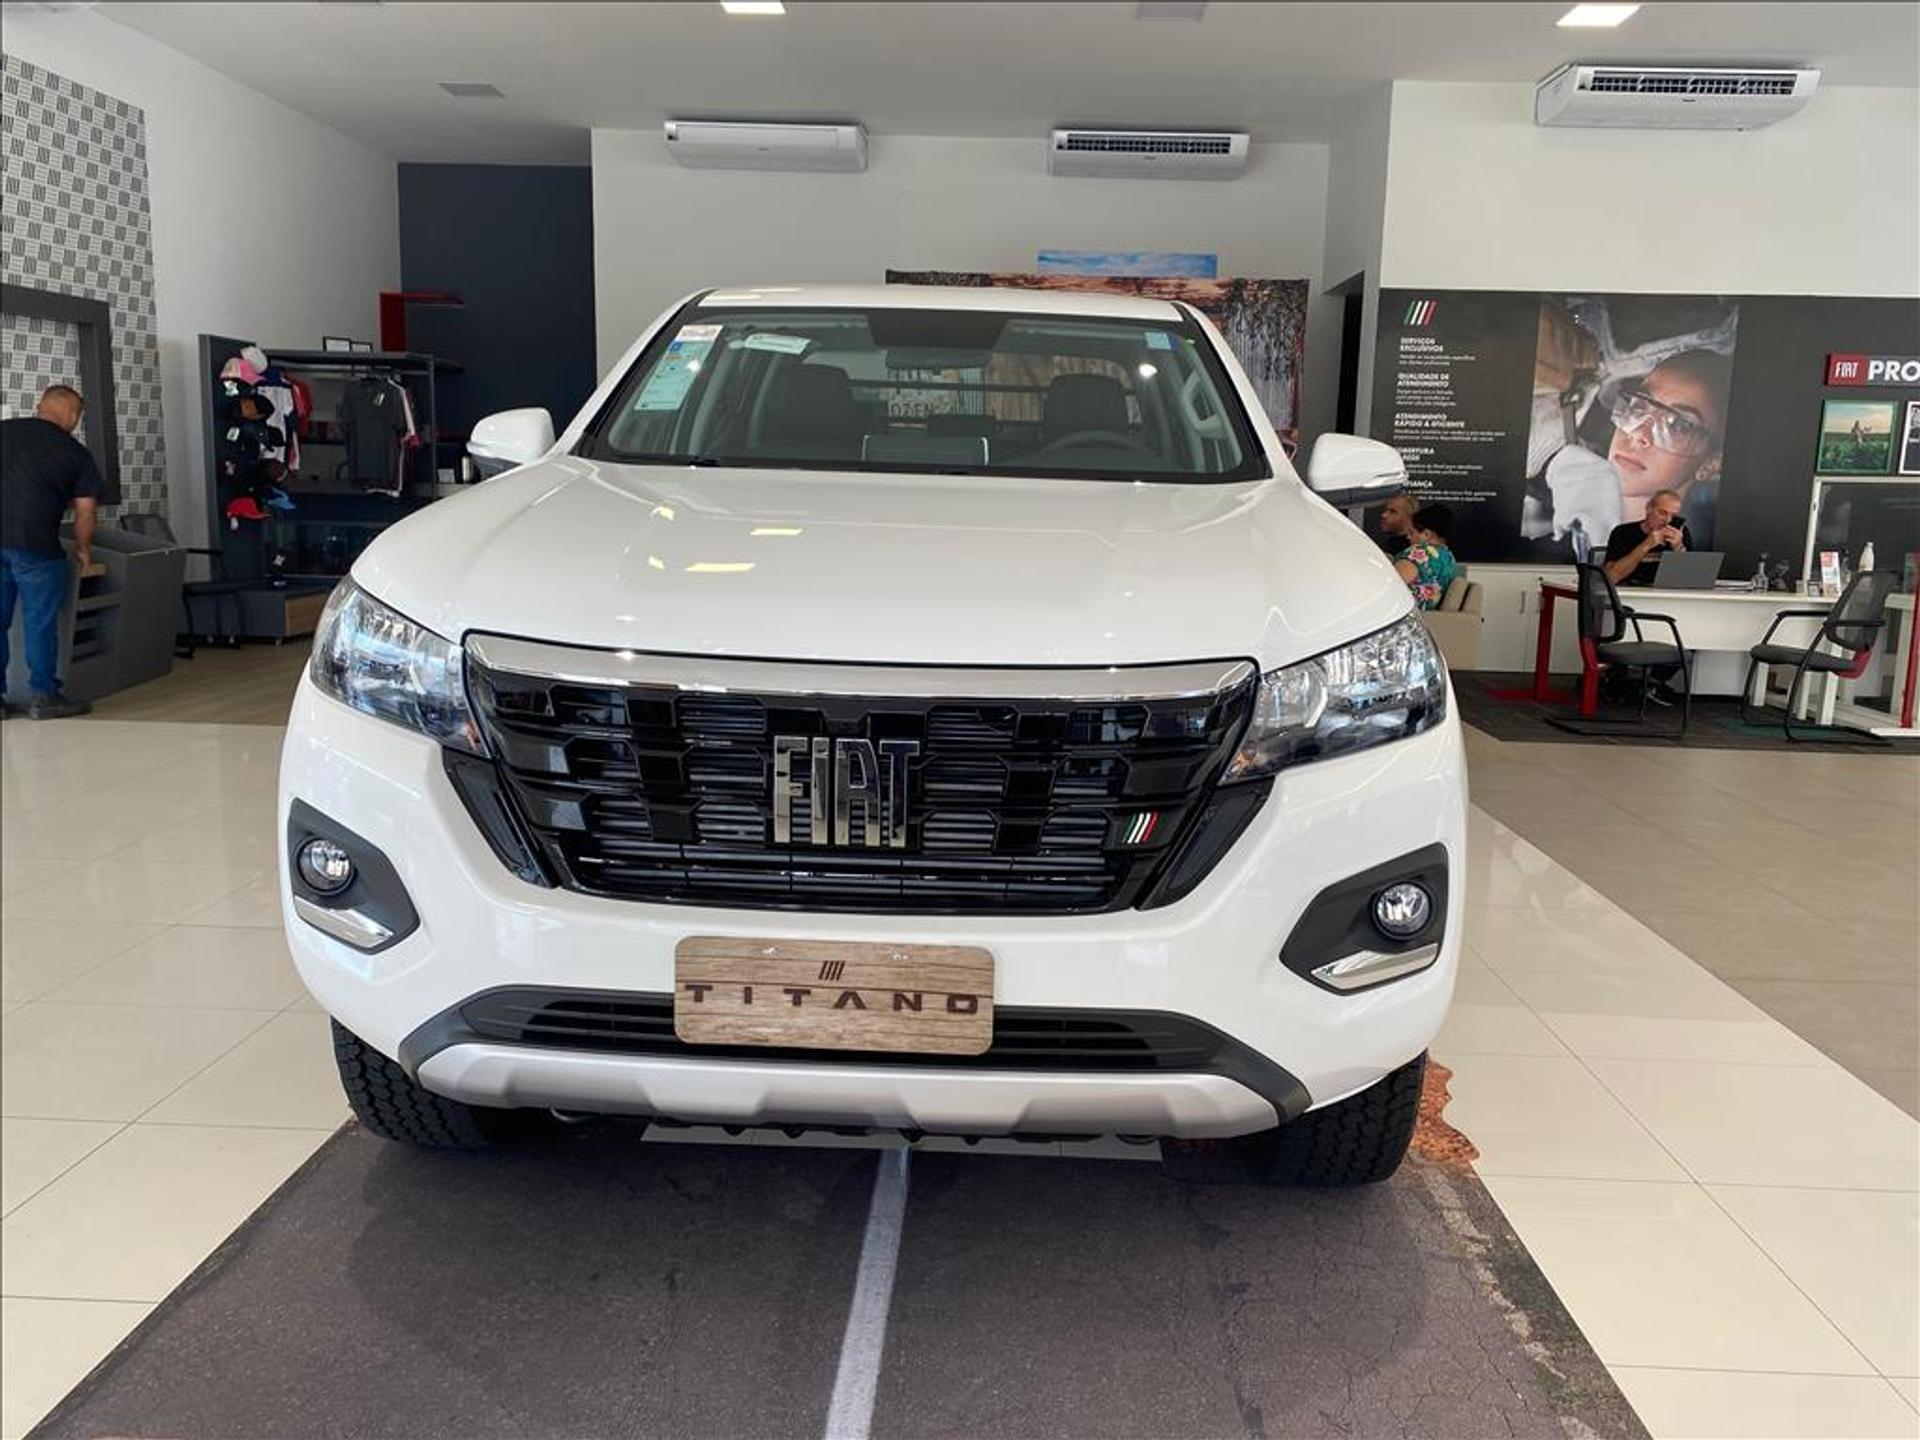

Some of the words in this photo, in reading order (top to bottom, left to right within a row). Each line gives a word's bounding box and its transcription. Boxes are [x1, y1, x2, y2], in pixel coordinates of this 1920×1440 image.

[1397, 373, 1439, 381] QUALIDADE
[1834, 361, 1860, 379] FIAT
[1867, 360, 1920, 382] PRO
[1397, 380, 1450, 388] ATENDIMENTO
[773, 734, 921, 848] FIAT
[684, 983, 979, 1015] TITANO
